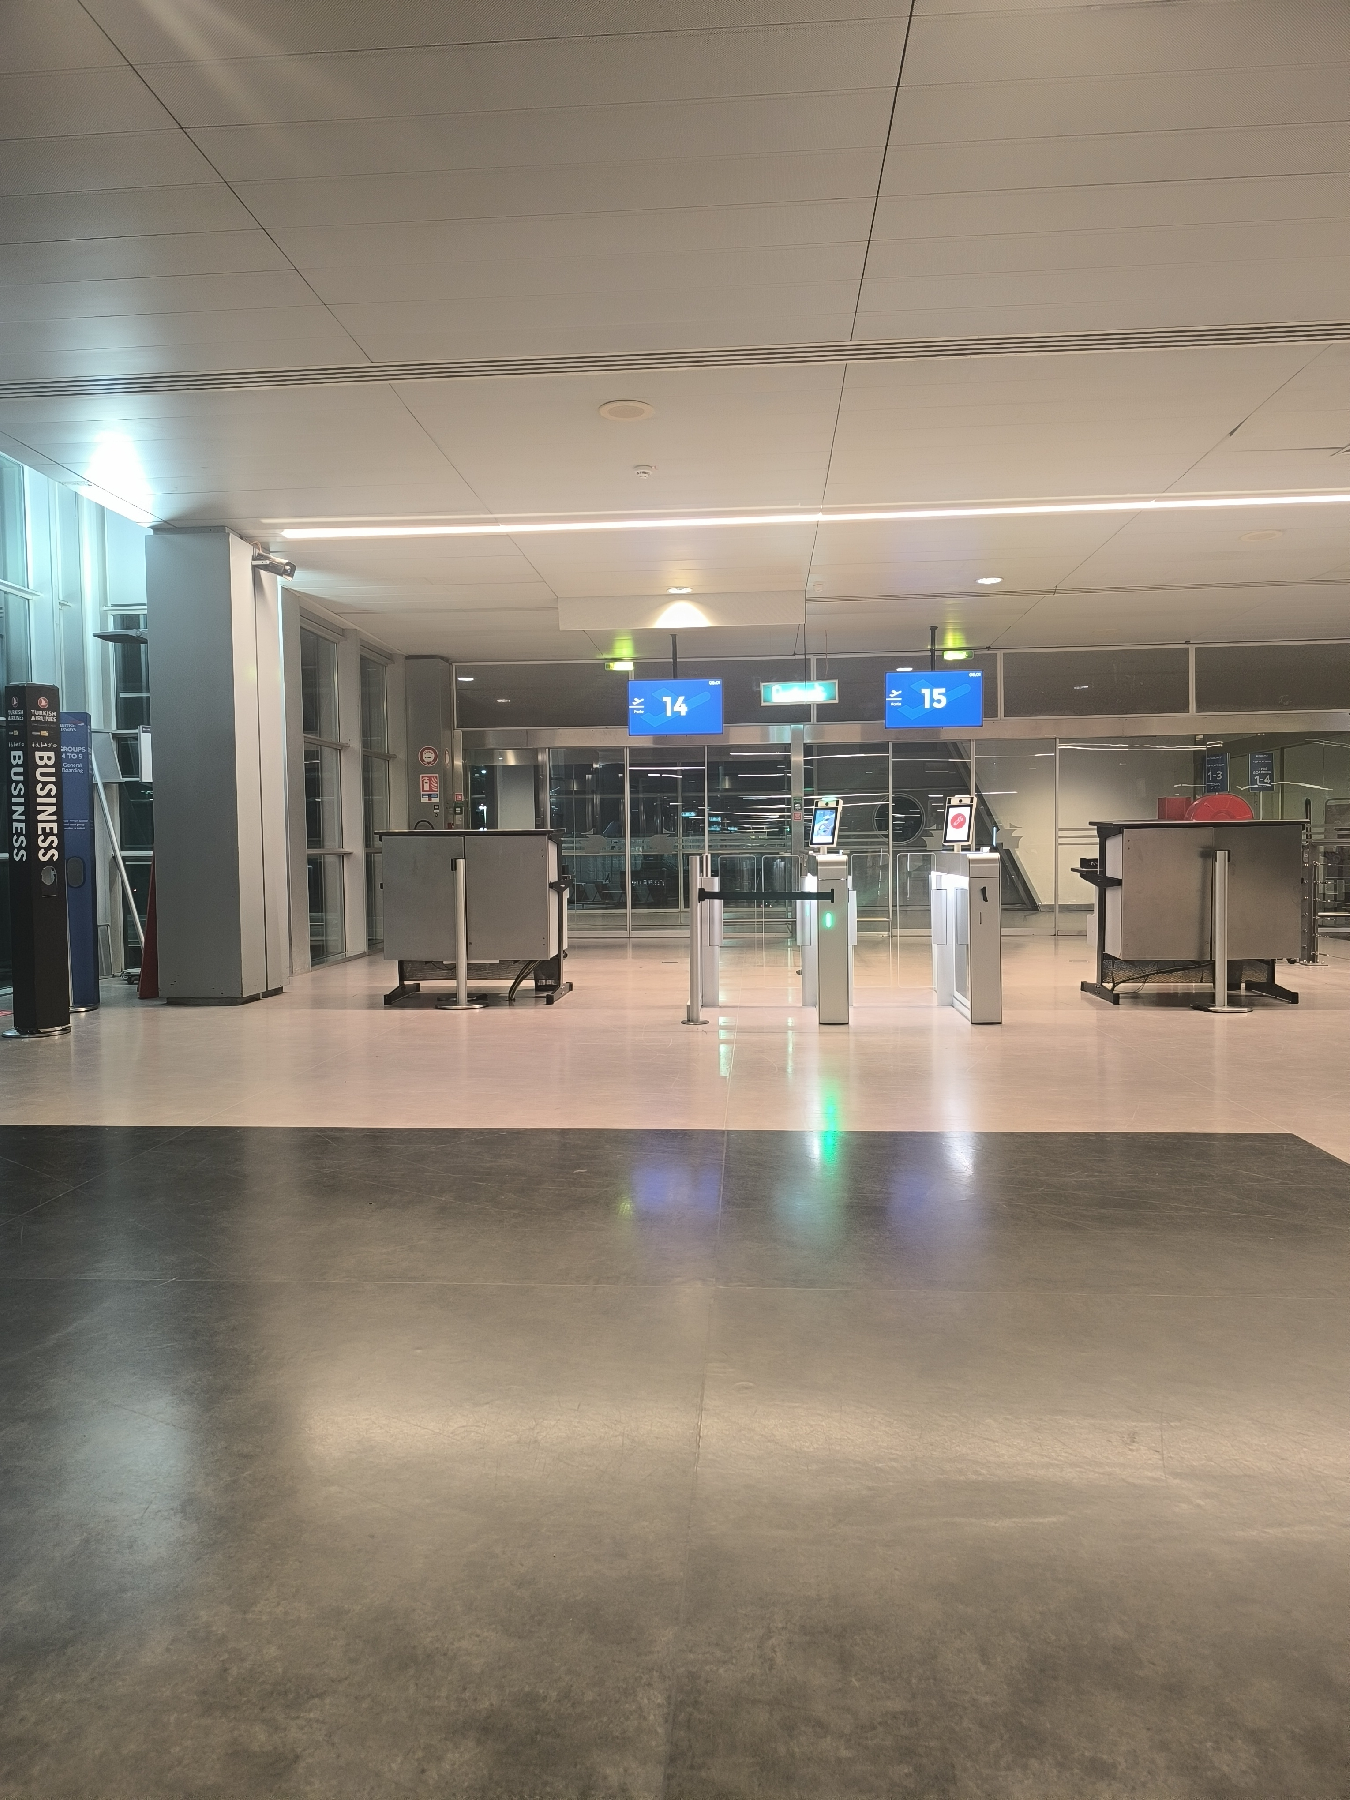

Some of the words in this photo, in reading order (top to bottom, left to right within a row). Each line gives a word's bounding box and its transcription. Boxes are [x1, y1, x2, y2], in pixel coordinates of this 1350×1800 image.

[662, 695, 688, 717] 14
[921, 687, 947, 709] 15
[30, 709, 57, 717] TURKISH
[11, 750, 27, 862] BUSINESS
[35, 751, 59, 862] BUSINESS
